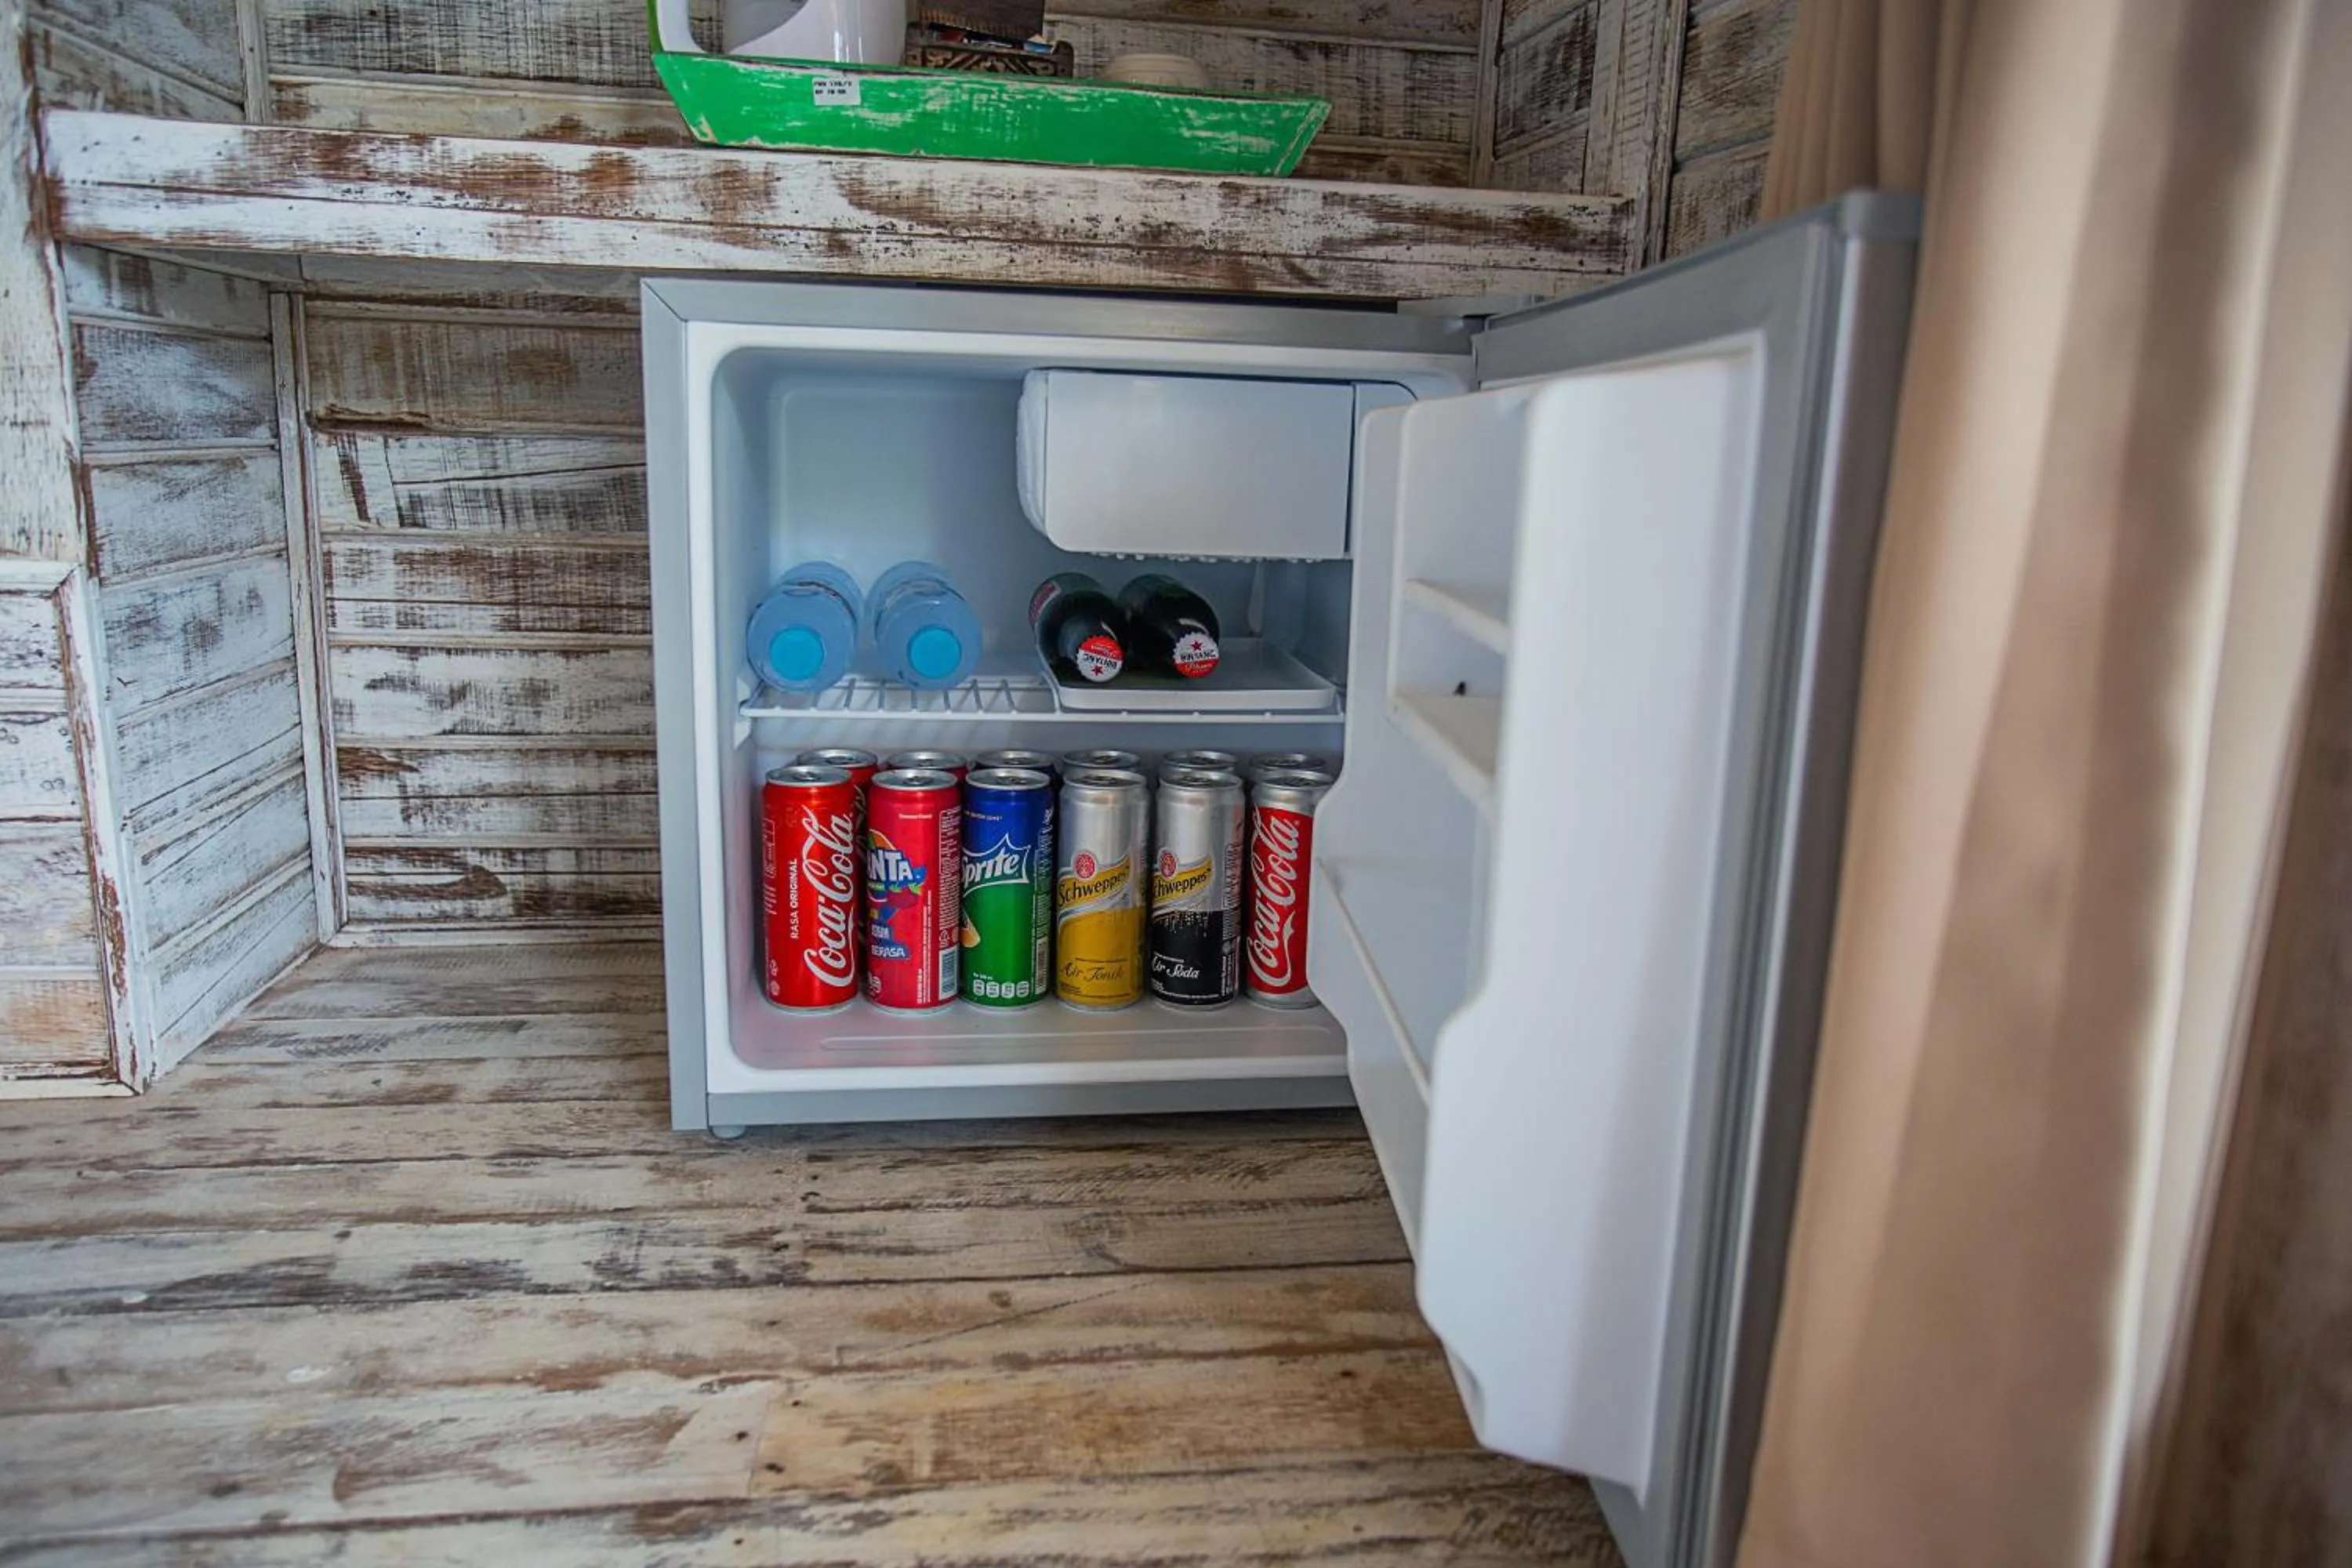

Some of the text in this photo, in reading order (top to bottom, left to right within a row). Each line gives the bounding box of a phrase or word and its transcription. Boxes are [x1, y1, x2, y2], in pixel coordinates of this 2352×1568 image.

[789, 858, 799, 939] RASA ORIGINAL
[800, 804, 855, 987] Coca-Cola
[1247, 803, 1299, 986] Coca-Cola
